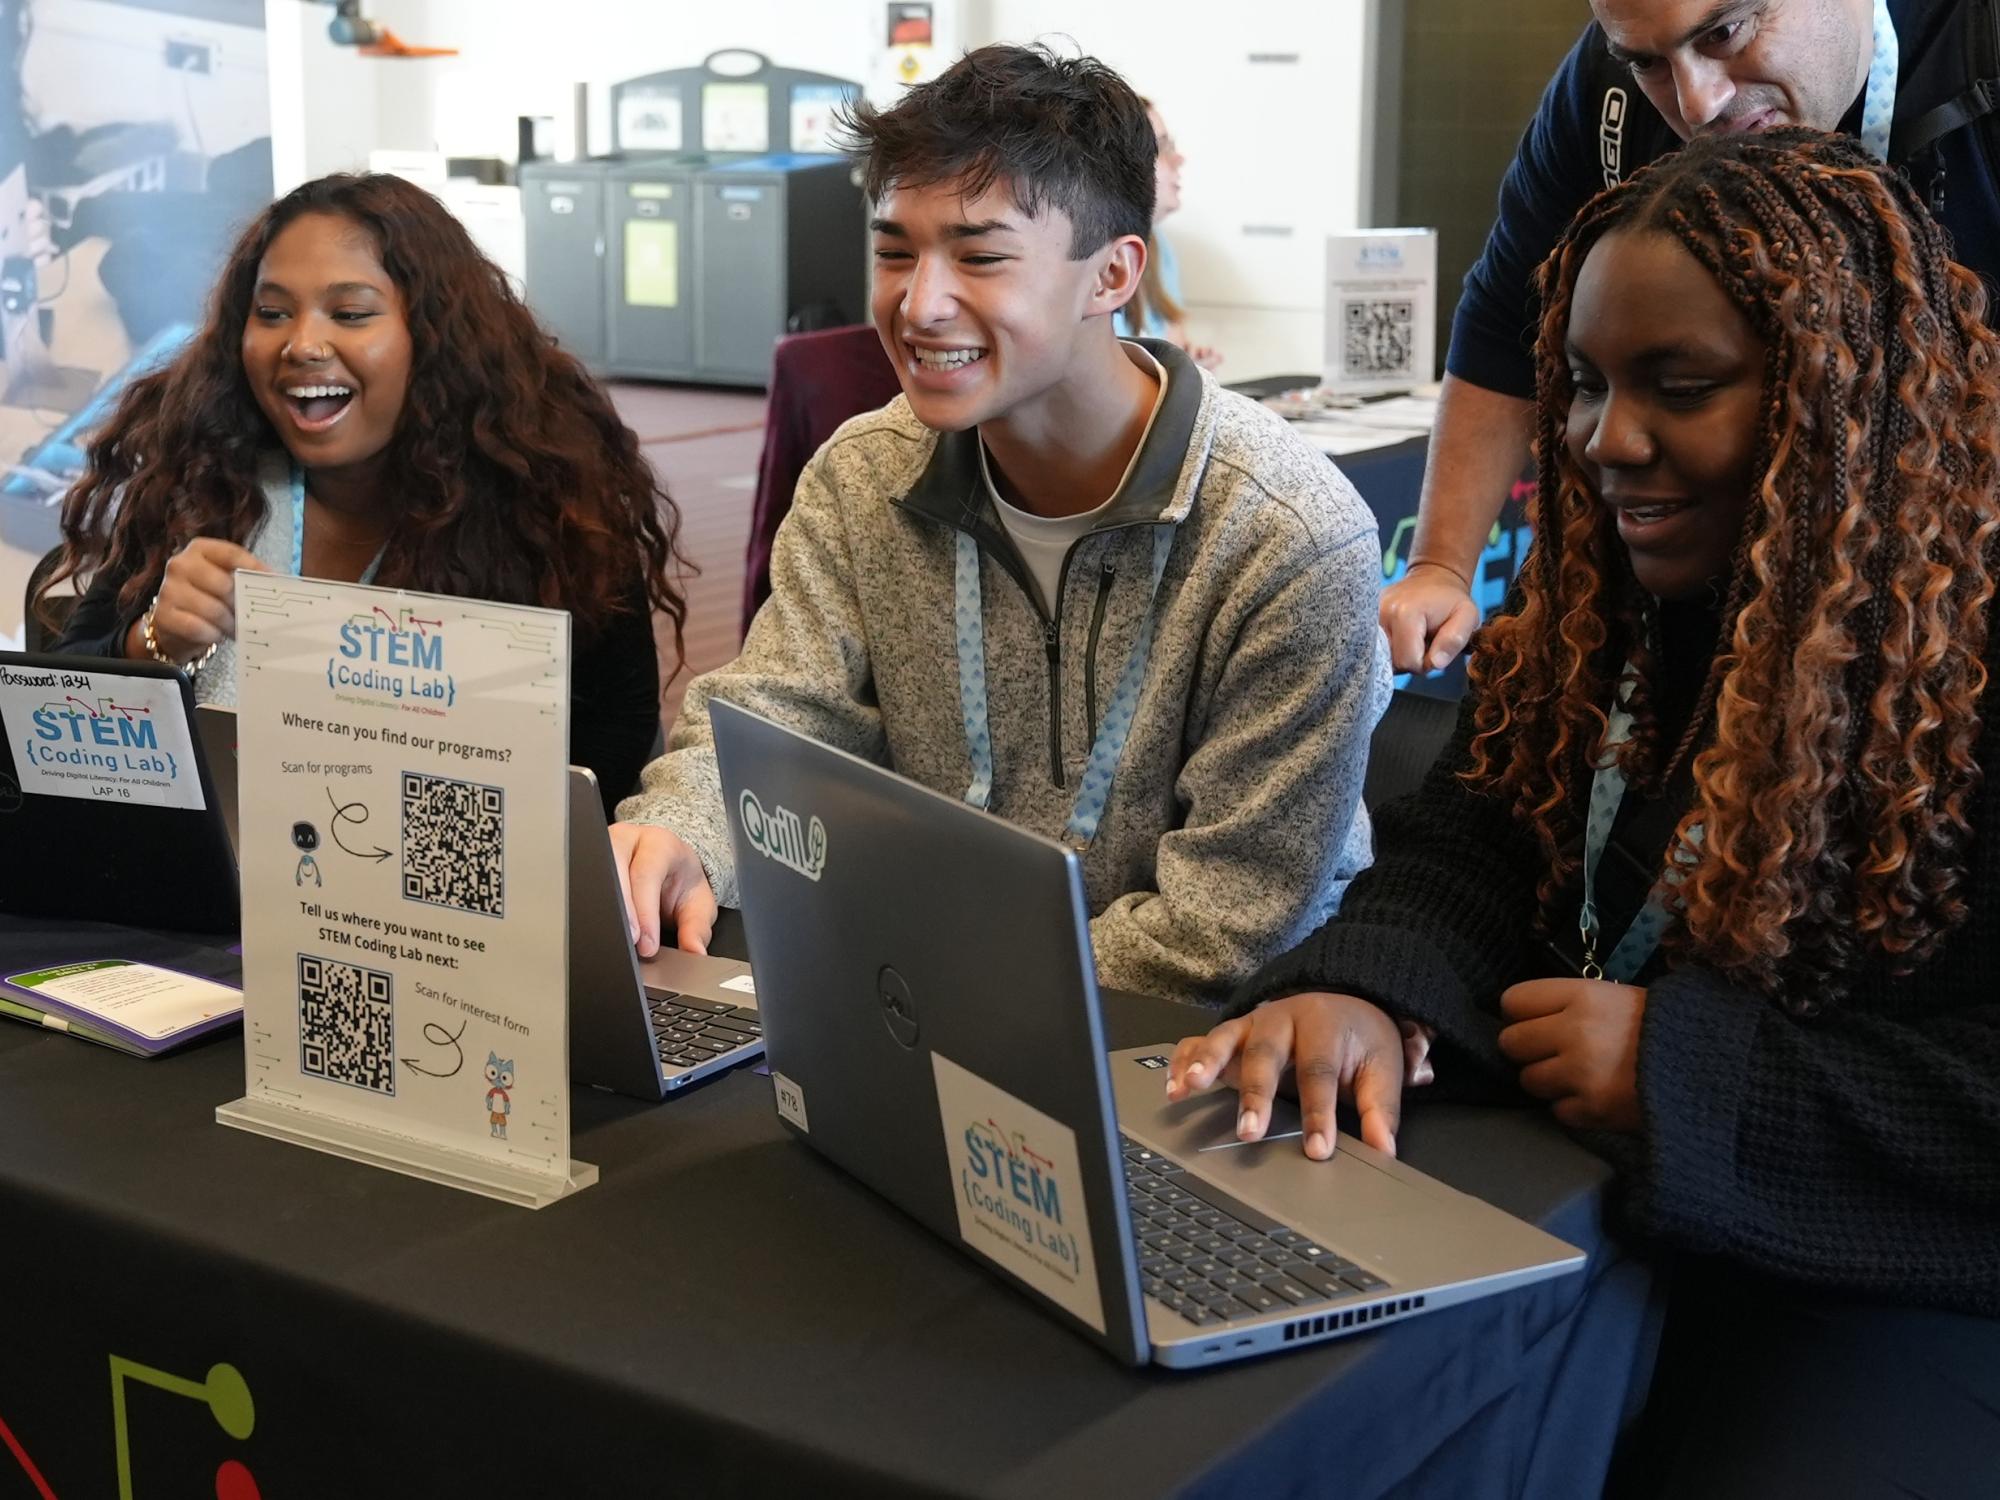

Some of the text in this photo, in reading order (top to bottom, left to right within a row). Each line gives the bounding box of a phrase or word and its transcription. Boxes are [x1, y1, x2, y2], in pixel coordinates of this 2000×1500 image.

[339, 623, 443, 671] STEM
[0, 666, 58, 687] Password:
[33, 710, 158, 750] STEM
[282, 711, 512, 762] Where can you find our programs?
[41, 769, 65, 778] Driving
[66, 771, 88, 780] Digital
[281, 760, 373, 777] Scan for programs
[92, 785, 131, 798] LAP 16
[300, 901, 486, 953] Tell us where you want to see
[318, 927, 459, 970] STEM Coding Lab next:
[415, 982, 530, 1036] Scan for interest form
[964, 1127, 1063, 1225] STEM
